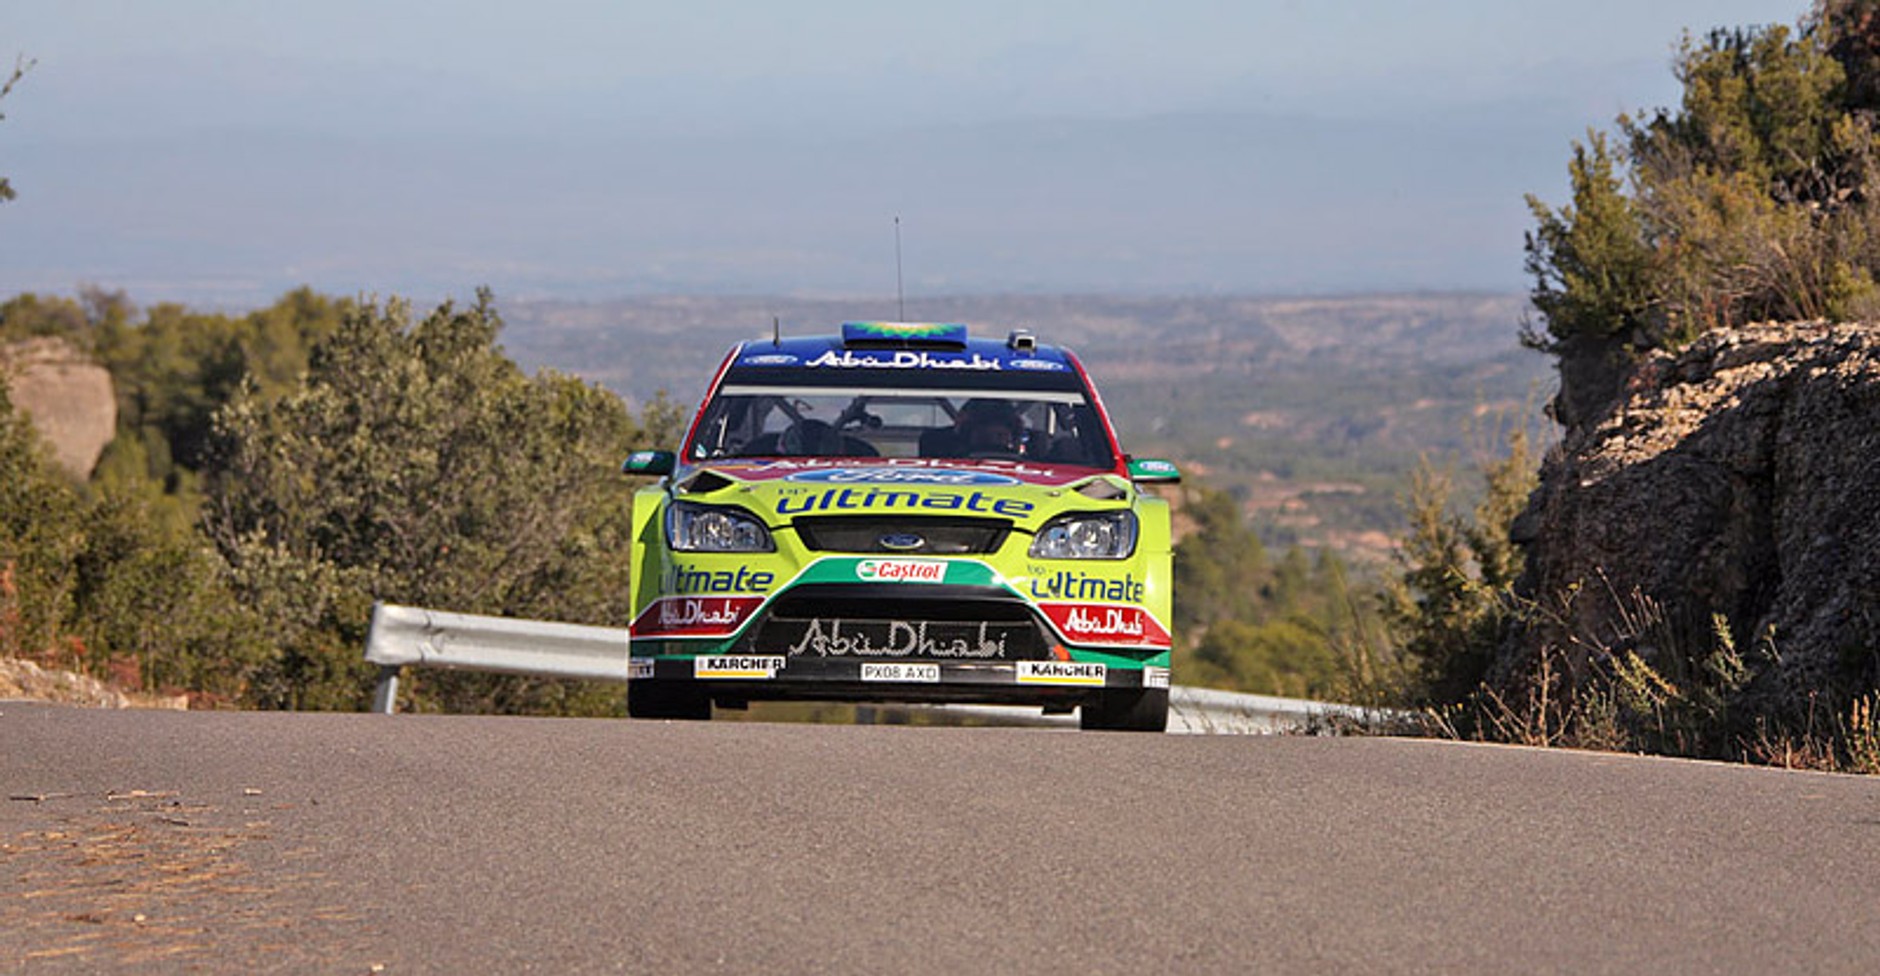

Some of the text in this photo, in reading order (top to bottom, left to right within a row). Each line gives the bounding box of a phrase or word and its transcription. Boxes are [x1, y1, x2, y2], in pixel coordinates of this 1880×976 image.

[776, 488, 1035, 518] ultimate
[878, 562, 942, 579] Castrol
[864, 667, 901, 679] PX08
